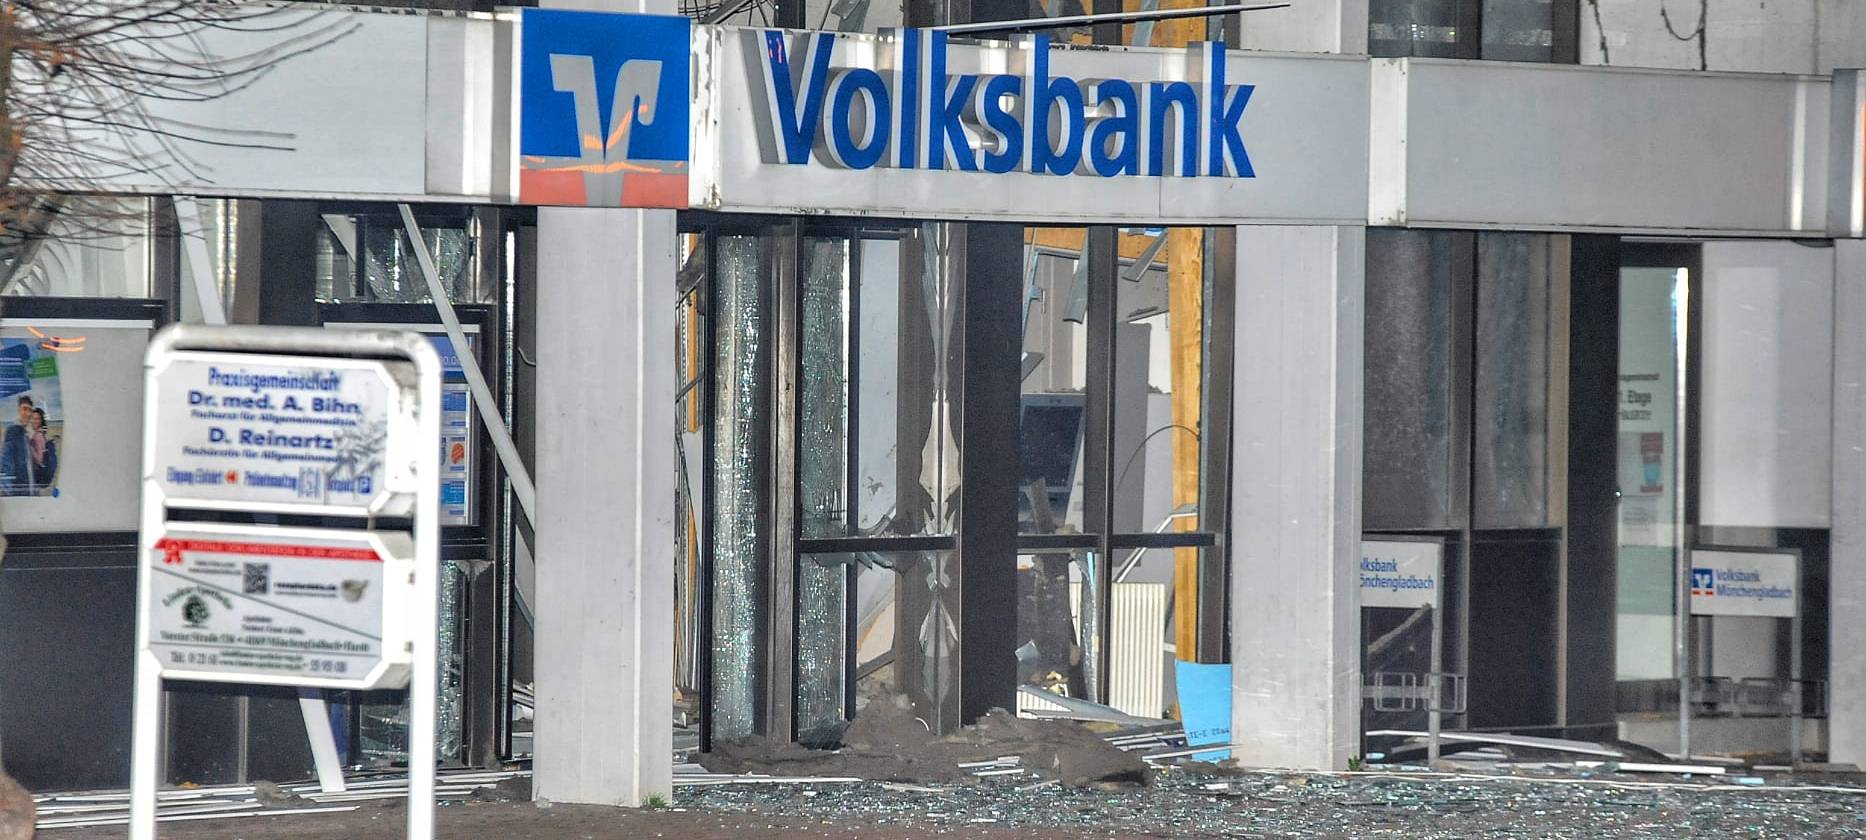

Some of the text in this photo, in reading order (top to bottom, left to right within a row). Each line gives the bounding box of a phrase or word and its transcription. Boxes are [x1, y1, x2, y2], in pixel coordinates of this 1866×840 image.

[742, 27, 1256, 178] Volksbank
[208, 367, 341, 393] Praxisgemeinschaft
[188, 390, 218, 406] Dr.
[222, 393, 275, 410] med.
[282, 396, 303, 411] A.
[239, 411, 257, 421] für
[208, 427, 334, 450] D. Reinartz
[1361, 557, 1397, 572] lksbank
[1360, 574, 1434, 592] önchengladbach
[1716, 569, 1760, 582] Volksbank
[1717, 584, 1793, 601] Mönchengladbach
